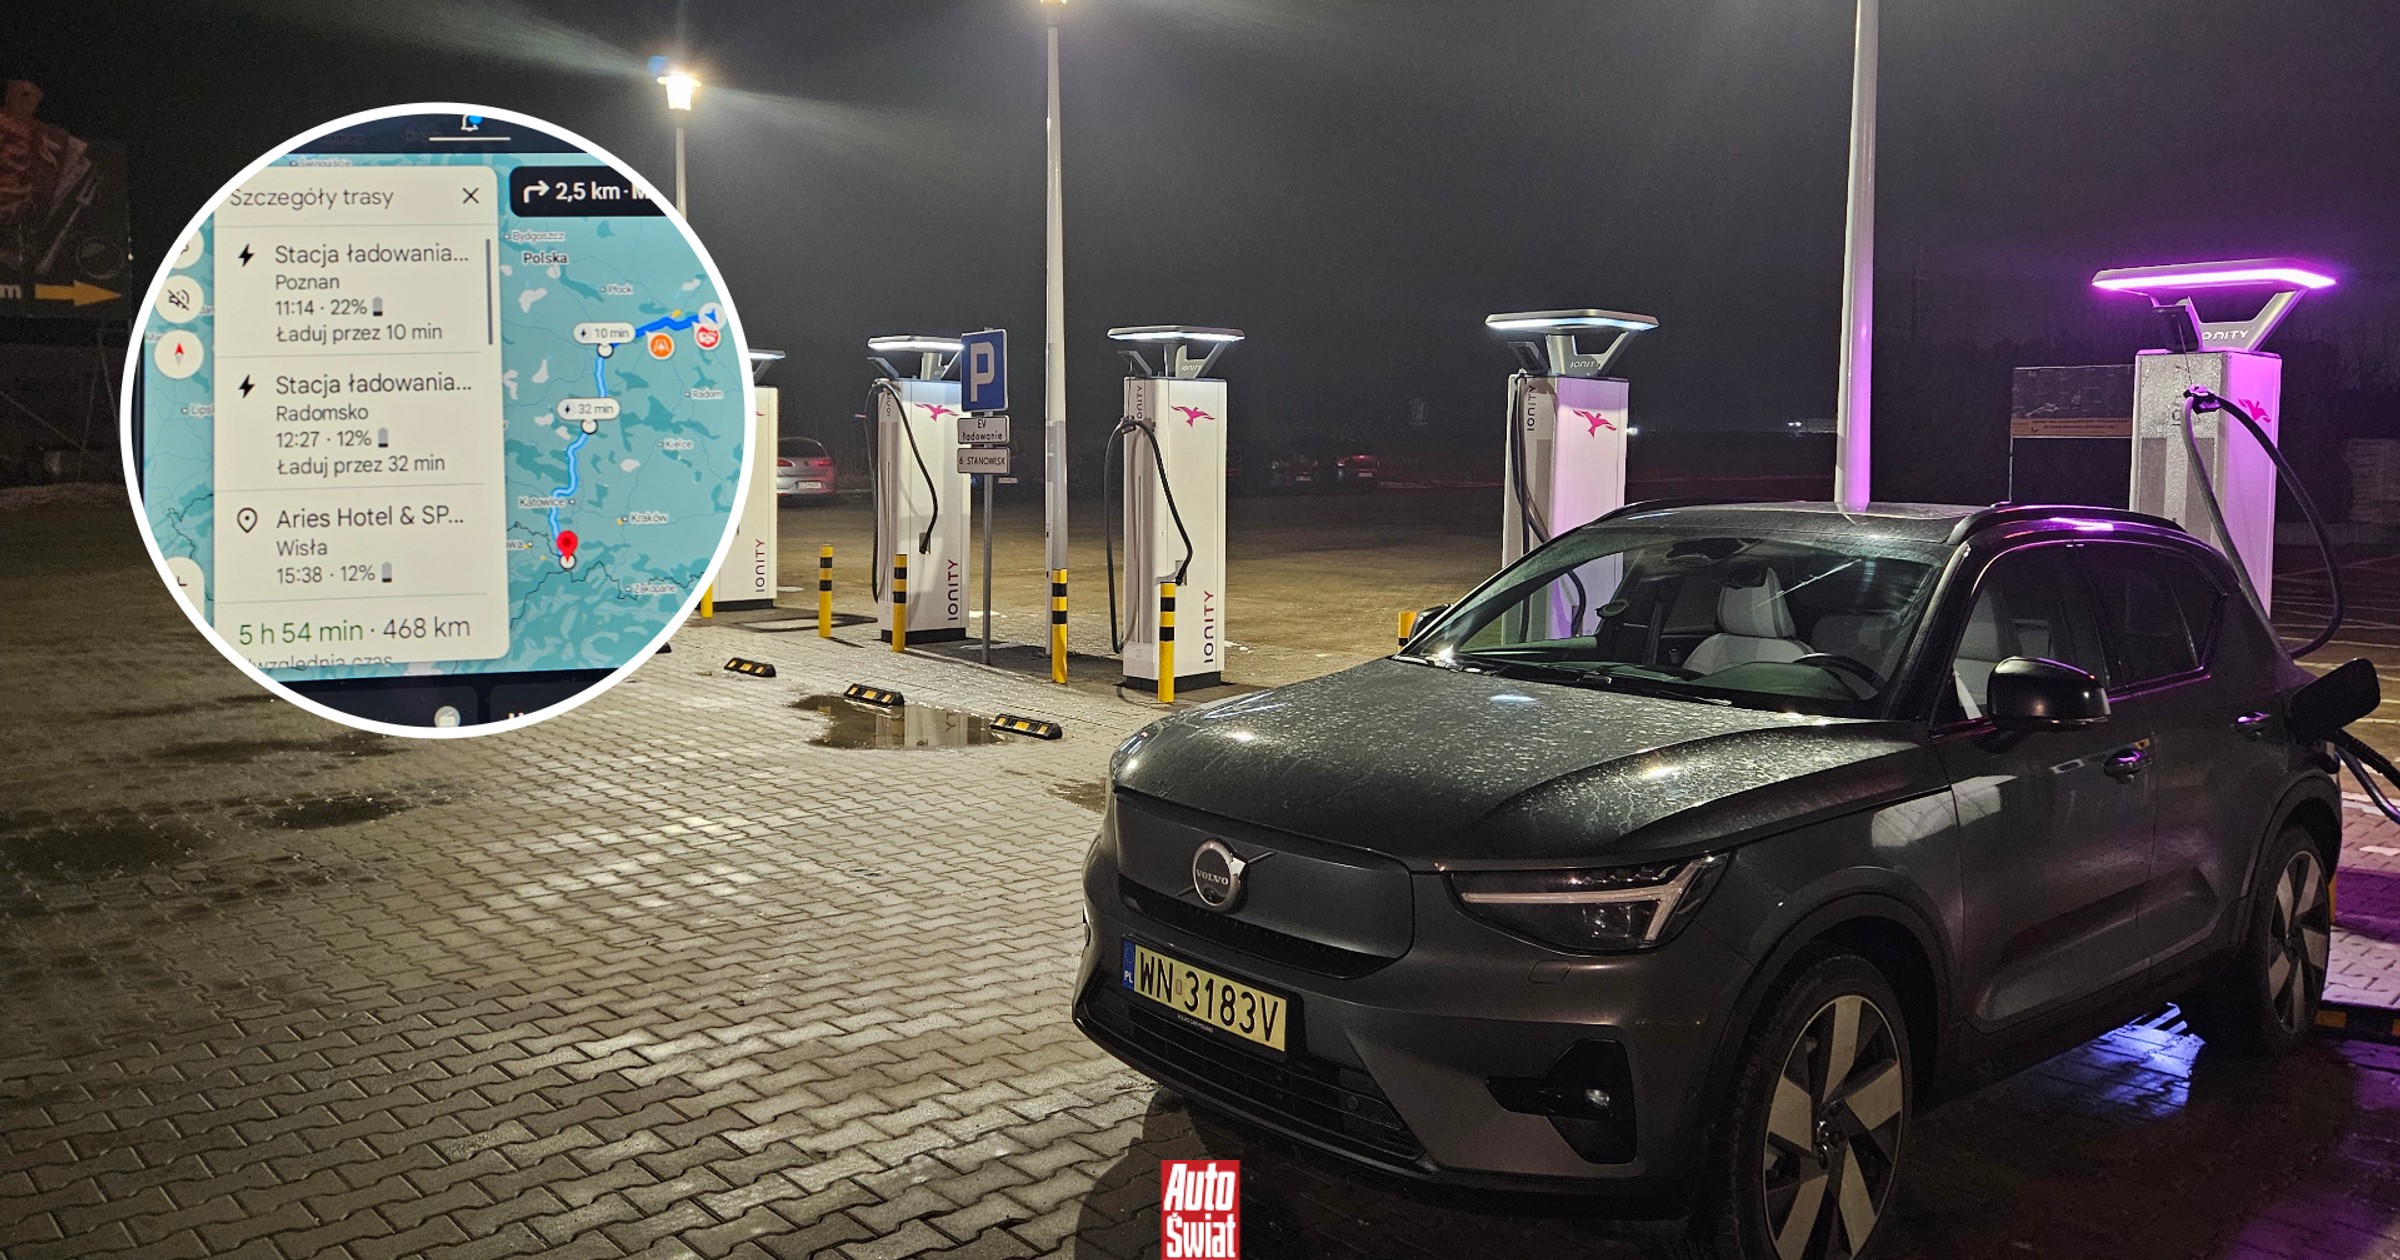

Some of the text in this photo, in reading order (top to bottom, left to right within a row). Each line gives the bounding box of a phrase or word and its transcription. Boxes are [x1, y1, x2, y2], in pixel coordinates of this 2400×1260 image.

[230, 188, 394, 211] Szczegóły trasy
[556, 182, 586, 202] 2,5
[591, 181, 620, 199] km
[512, 231, 564, 243] Bydgoszcz
[275, 243, 468, 267] Stacja ładowania...
[523, 252, 567, 264] Polska
[276, 275, 340, 290] Poznan
[276, 299, 367, 315] 11:14 22%
[276, 323, 442, 344] Ładuj przez 10 min
[595, 327, 630, 338] 10 min
[970, 342, 995, 402] P
[276, 372, 471, 398] Stacja ładowania...
[693, 388, 721, 398] Radom
[277, 403, 368, 421] Radomsko
[578, 403, 613, 414] 32 min
[976, 418, 987, 429] EV
[277, 430, 372, 448] 12:27 12%
[666, 439, 692, 449] Kielce
[277, 454, 445, 478] Ładuj przez 32 min
[958, 457, 964, 466] 6
[519, 498, 565, 507] Katowice
[276, 505, 463, 528] Aries Hotel & SP...
[631, 512, 667, 523] Kraków
[276, 539, 327, 556] Wisła
[277, 565, 375, 584] 15:38 12%
[755, 539, 765, 593] IONITY
[948, 558, 959, 621] IONITY
[240, 616, 470, 645] 5 h 54 min 468 km
[1204, 590, 1214, 663] IONITY
[1196, 869, 1229, 885] VOLVO
[1124, 971, 1133, 983] PL
[1139, 951, 1279, 1043] WN 3183V
